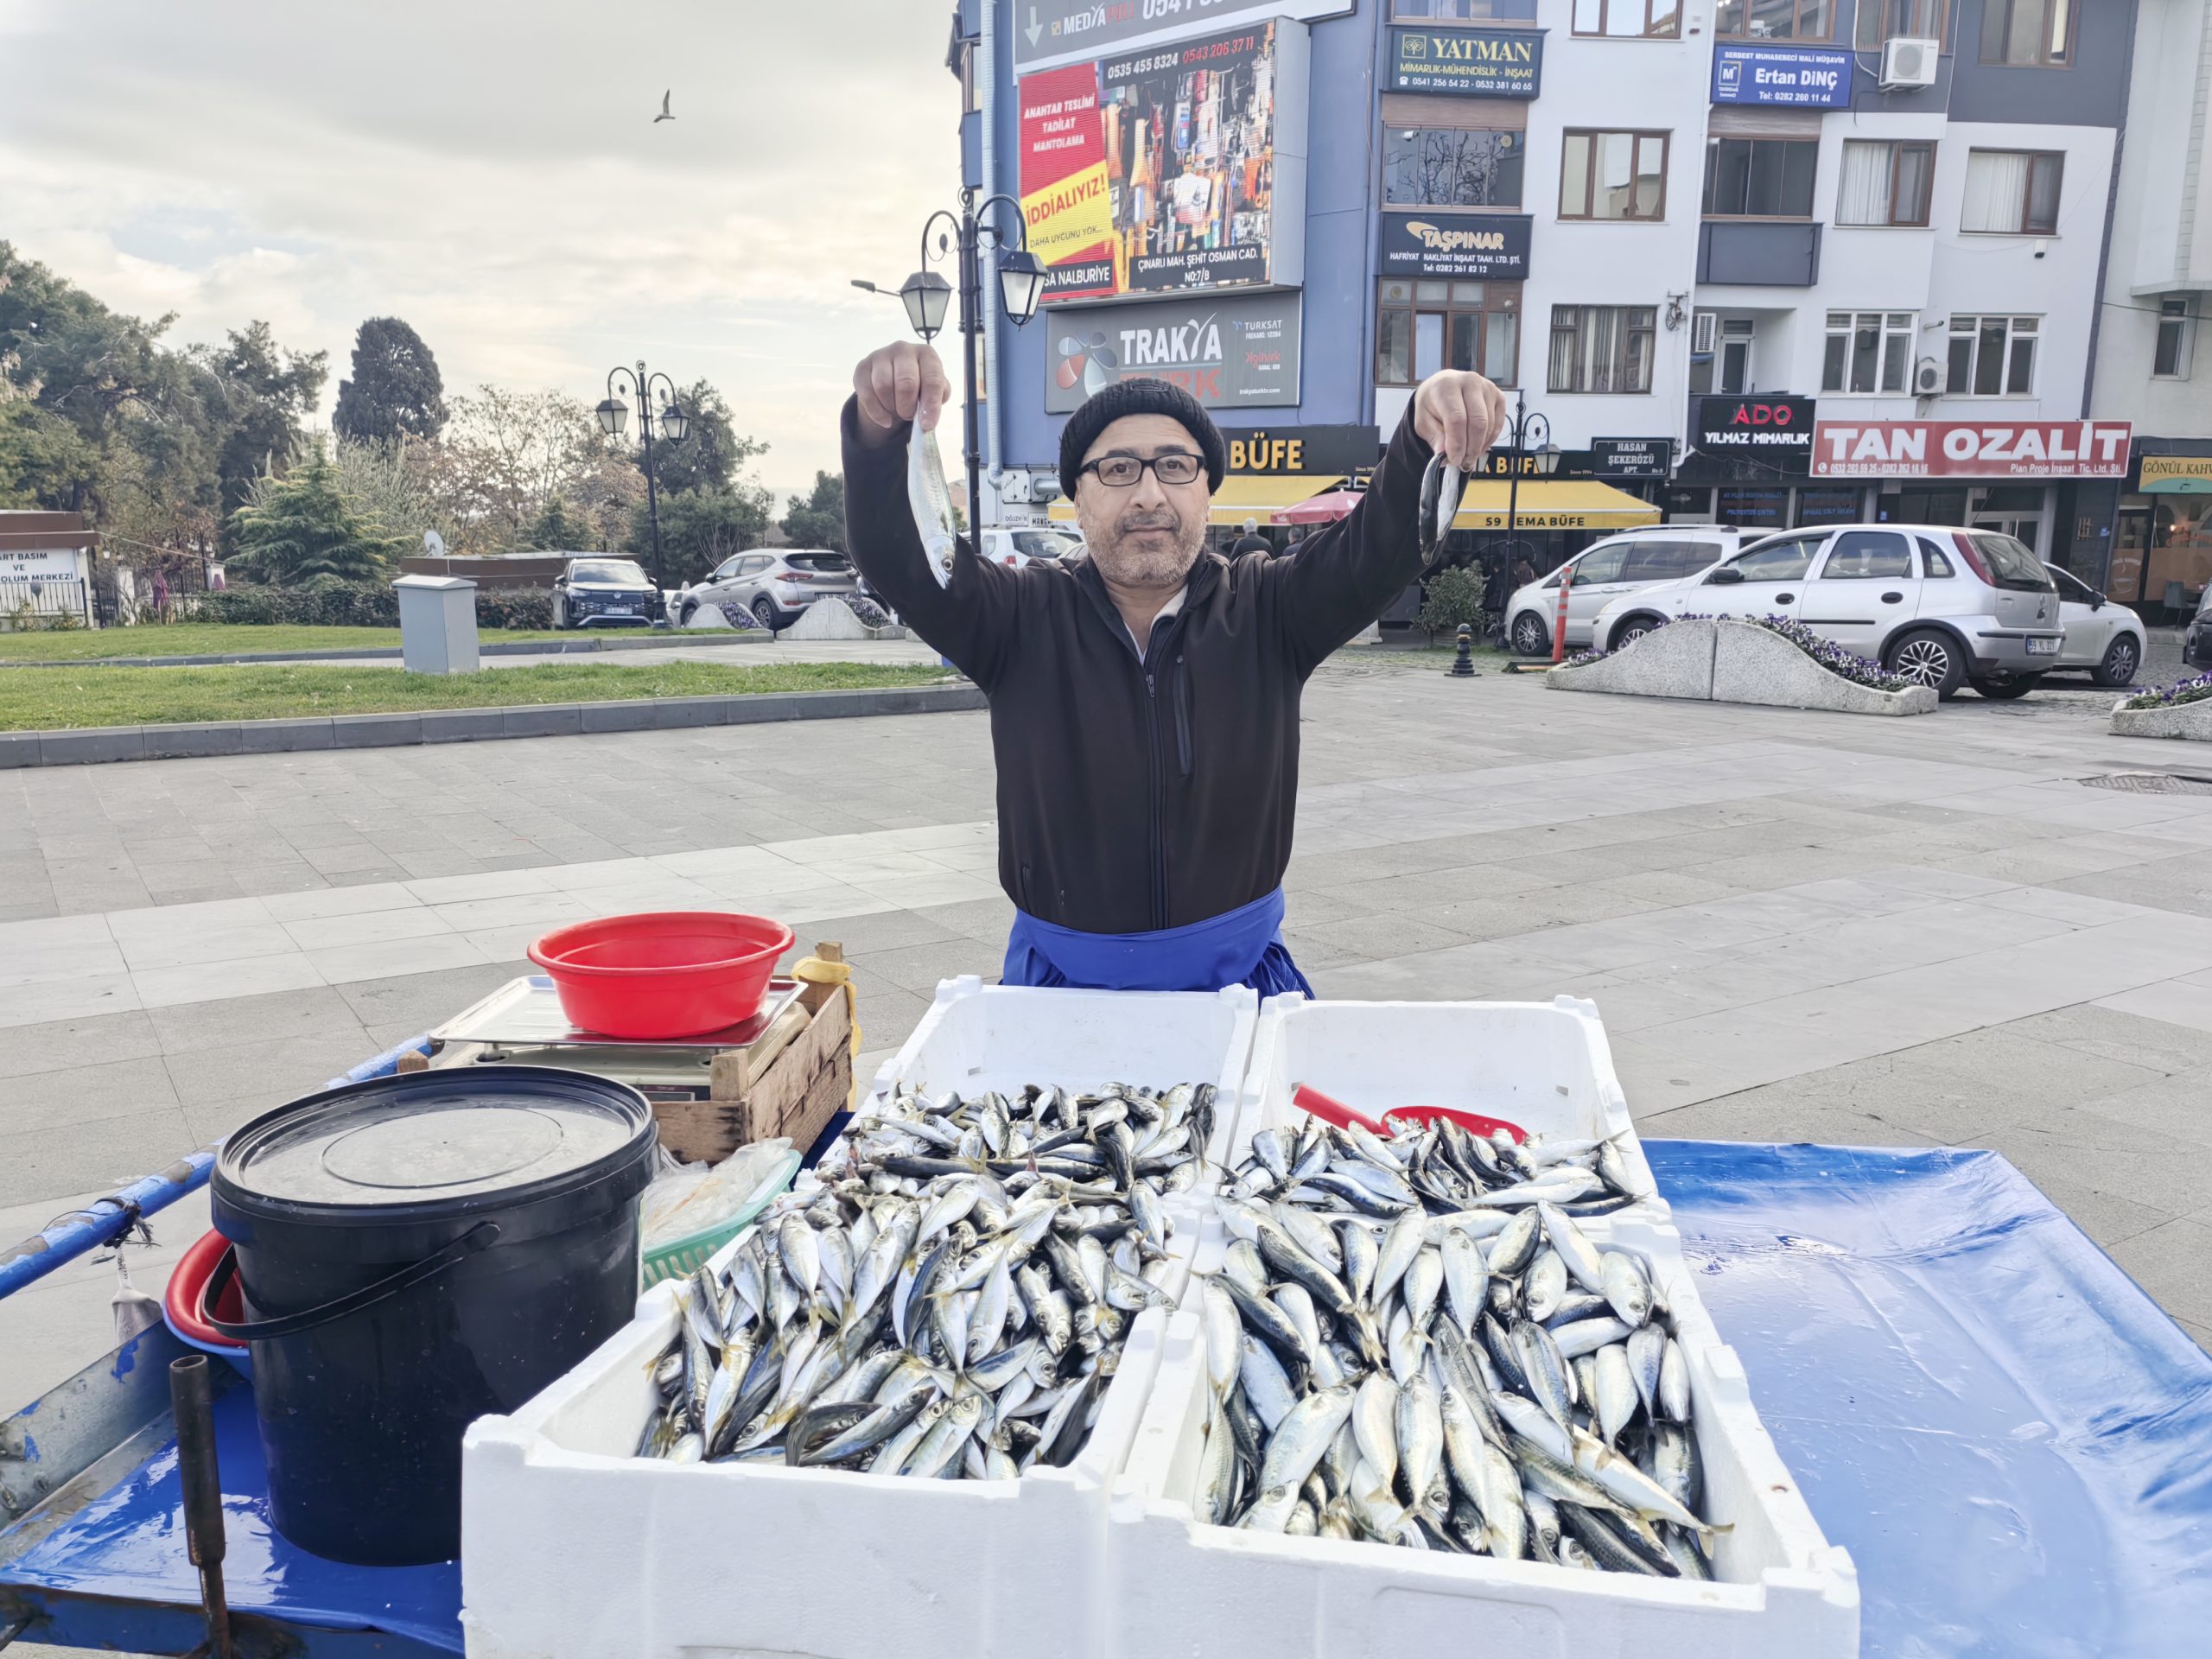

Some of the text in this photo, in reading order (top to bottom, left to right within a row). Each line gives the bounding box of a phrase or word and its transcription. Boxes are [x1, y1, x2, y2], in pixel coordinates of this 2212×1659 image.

[1108, 62, 1131, 79] 0535
[1134, 59, 1152, 73] 455
[1154, 52, 1179, 69] 8324
[1182, 47, 1209, 65] 0543
[1231, 38, 1245, 54] 37
[1246, 36, 1255, 50] 11
[1432, 37, 1533, 63] YATMAN
[1725, 51, 1845, 65] SERBEST MUHASEBECİ MALİ MÜŞAVİR
[1400, 61, 1497, 77] MİMARLIK-MÜHENDİSLİK
[1504, 65, 1533, 79] İNŞAAT
[1755, 68, 1796, 85] Ertan
[1412, 77, 1431, 86] 0541
[1433, 78, 1446, 86] 256
[1448, 79, 1458, 87] 54
[1476, 80, 1494, 89] 0532
[1496, 81, 1509, 90] 381
[1522, 82, 1533, 91] 65
[1024, 92, 1095, 119] ANAHTAR TESLİMİ
[1759, 91, 1773, 99] Tel:
[1775, 92, 1794, 101] 0282
[1811, 93, 1819, 102] 11
[1821, 93, 1831, 103] 44
[1042, 116, 1076, 134] TADİLAT
[1033, 134, 1085, 152] MANTOLAMA
[1026, 173, 1106, 227] İDDİALIYIZ!
[1030, 236, 1050, 249] DAHA
[1051, 229, 1081, 244] UYGUNU
[1422, 230, 1504, 252] TAŞPINAR
[1138, 247, 1258, 272] ÇINARLI MAH. ŞEHİT OSMAN CAD.
[1389, 251, 1521, 265] HAFRİYAT NAKLİYAT İNŞAAT TAAH. LTD. ŞTİ.
[1058, 265, 1110, 286] NALBURİYE
[1120, 312, 1223, 365] TRAKYA
[1120, 369, 1222, 398] RK
[1732, 404, 1793, 425] ADO
[1705, 432, 1750, 443] YILMAZ
[1823, 428, 1927, 461] TAN
[1230, 431, 1303, 470] BÜFE
[1617, 442, 1647, 452] HASAN
[1608, 454, 1655, 467] ŞEKERÖZÜ
[2011, 463, 2028, 474] Plan
[2029, 463, 2049, 475] Proje
[2051, 461, 2075, 474] İnşaat
[2079, 463, 2091, 473] Tic.
[2094, 464, 2107, 474] Ltd.
[2143, 461, 2183, 474] GÖNÜL
[1485, 514, 1585, 526] 59 EMA BÜFE
[18, 552, 48, 561] BASIM
[32, 571, 73, 582] MERKEZİ
